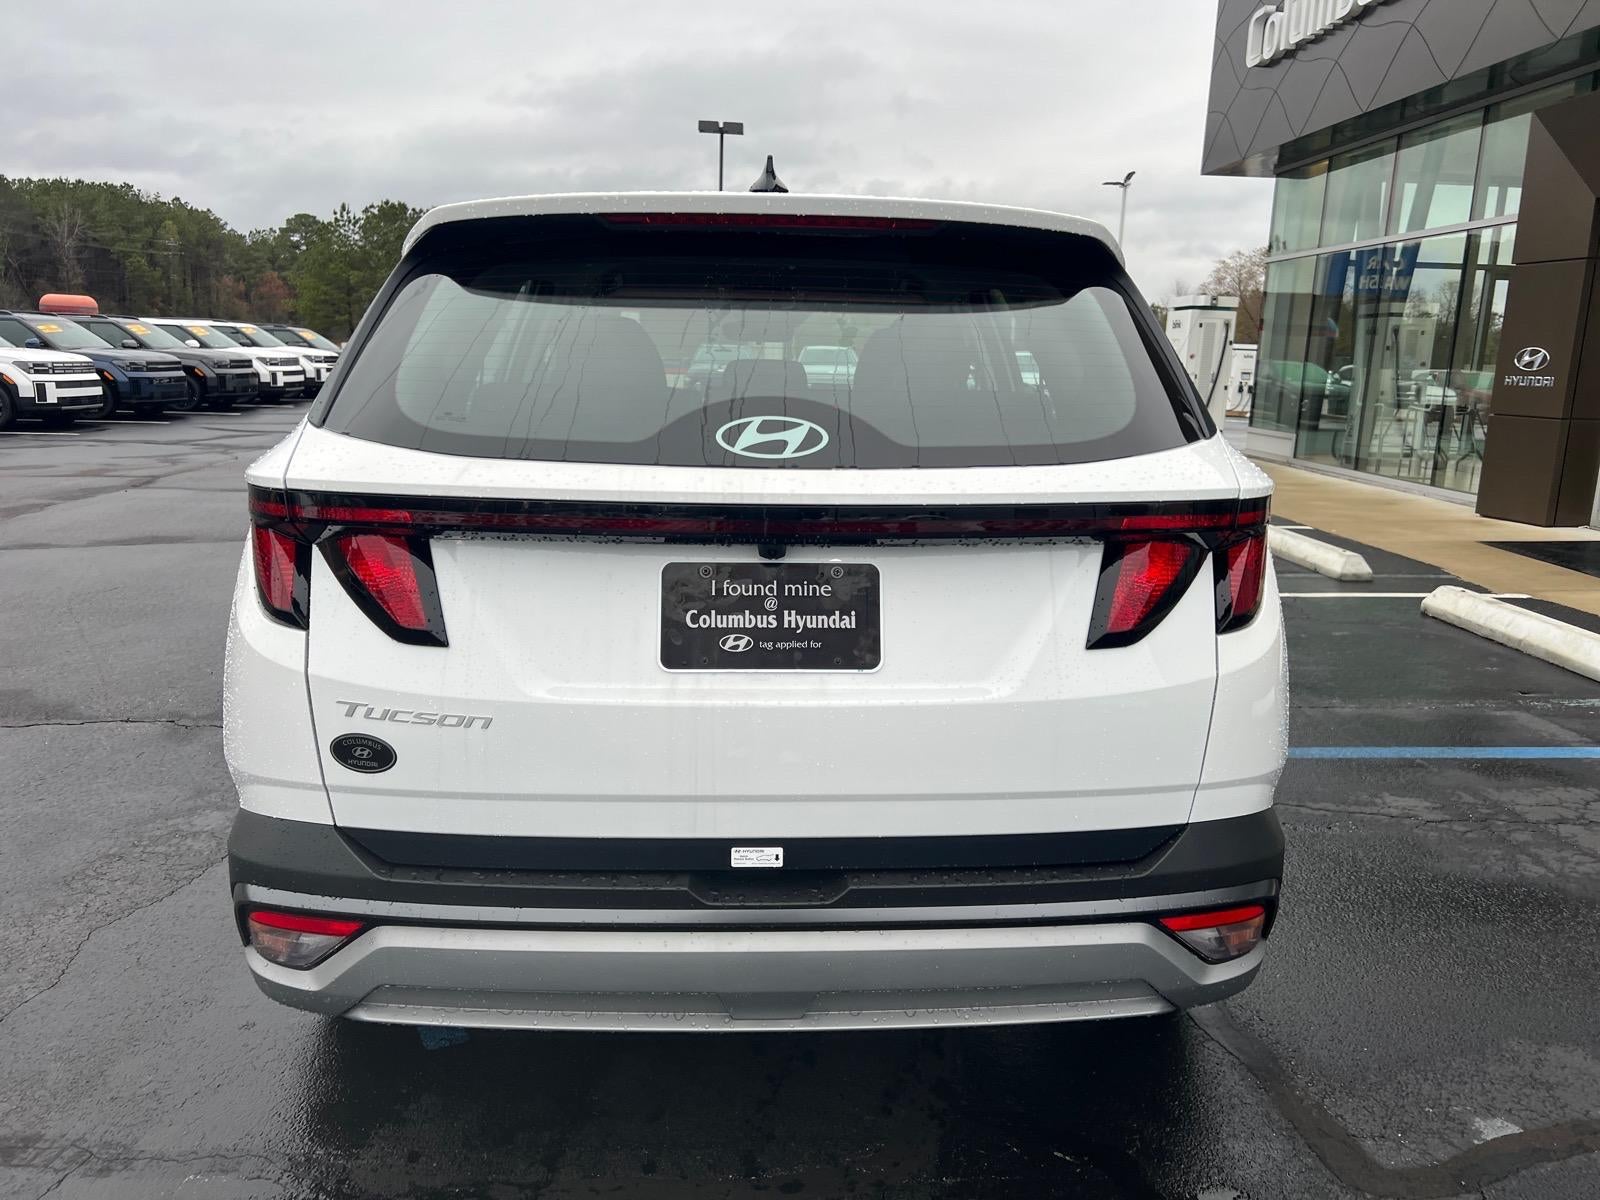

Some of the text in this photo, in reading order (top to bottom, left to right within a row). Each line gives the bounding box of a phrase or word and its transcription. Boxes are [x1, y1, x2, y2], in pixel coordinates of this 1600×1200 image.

[1246, 0, 1375, 68] Colum
[1504, 375, 1555, 387] HYUNDAI
[711, 580, 832, 597] I found mine
[764, 597, 778, 611] @
[685, 610, 856, 633] Columbus Hyundai
[759, 639, 822, 650] tag applied for
[342, 738, 382, 750] COLUMBUS
[347, 759, 379, 768] HYUNDAI
